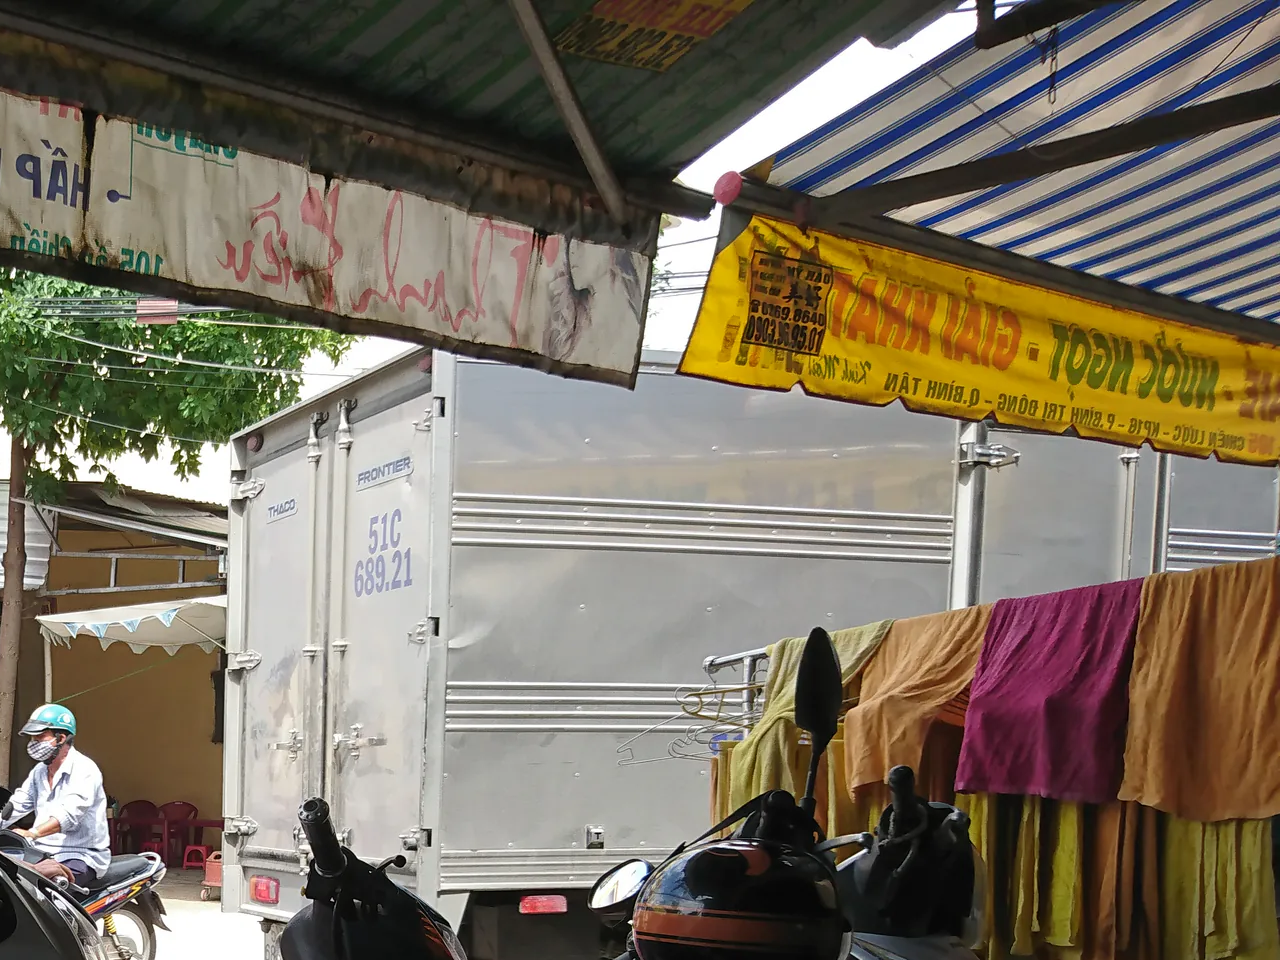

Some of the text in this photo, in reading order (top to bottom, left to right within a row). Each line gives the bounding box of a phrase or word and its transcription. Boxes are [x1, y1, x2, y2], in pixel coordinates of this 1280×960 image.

[357, 455, 412, 486] FRONTIER
[268, 498, 296, 519] THACO
[368, 508, 402, 555] 51C
[354, 547, 413, 598] 689.21
